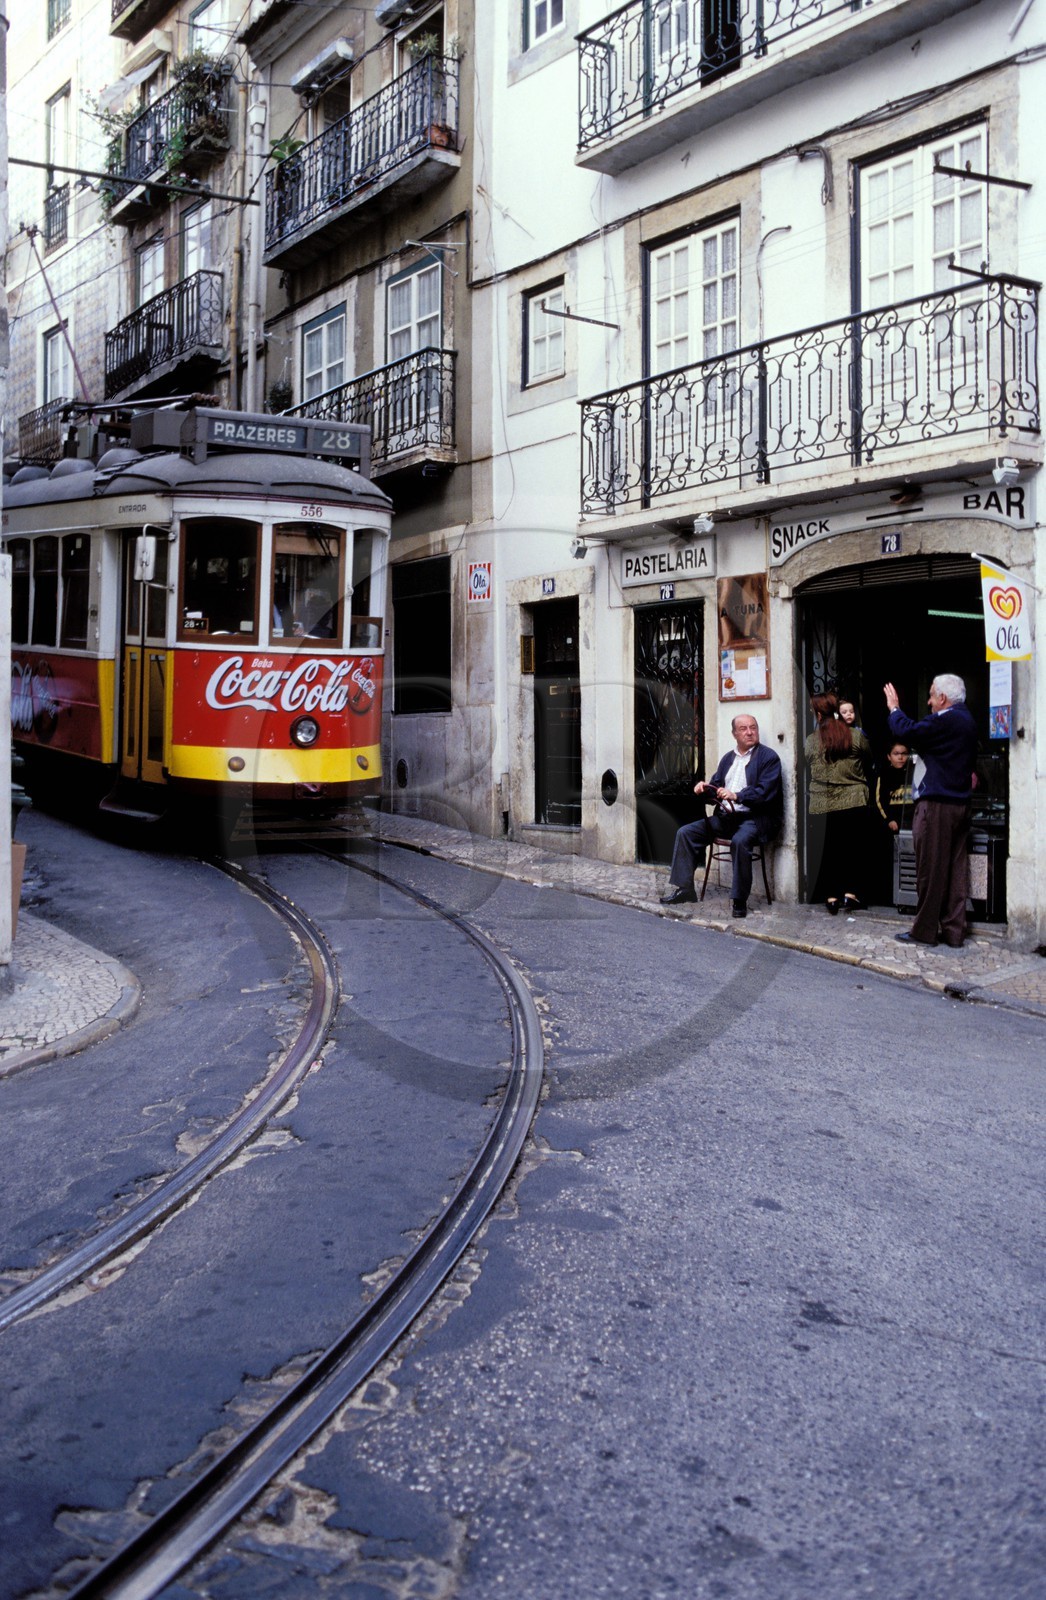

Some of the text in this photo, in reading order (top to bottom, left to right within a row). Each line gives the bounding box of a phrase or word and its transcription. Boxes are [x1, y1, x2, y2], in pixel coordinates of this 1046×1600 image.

[214, 421, 297, 444] PRAZERES
[321, 430, 351, 450] 28
[118, 504, 147, 514] ENTRADA
[300, 506, 323, 518] 556
[772, 486, 1026, 559] SNACK BAR
[884, 535, 898, 552] 78
[625, 547, 708, 578] PASTELARIA
[473, 573, 487, 589] Olá
[544, 579, 554, 593] 80
[735, 602, 764, 617] TUNA
[995, 626, 1022, 651] Olá
[251, 657, 274, 668] Beba
[205, 655, 354, 712] Coca-Cola
